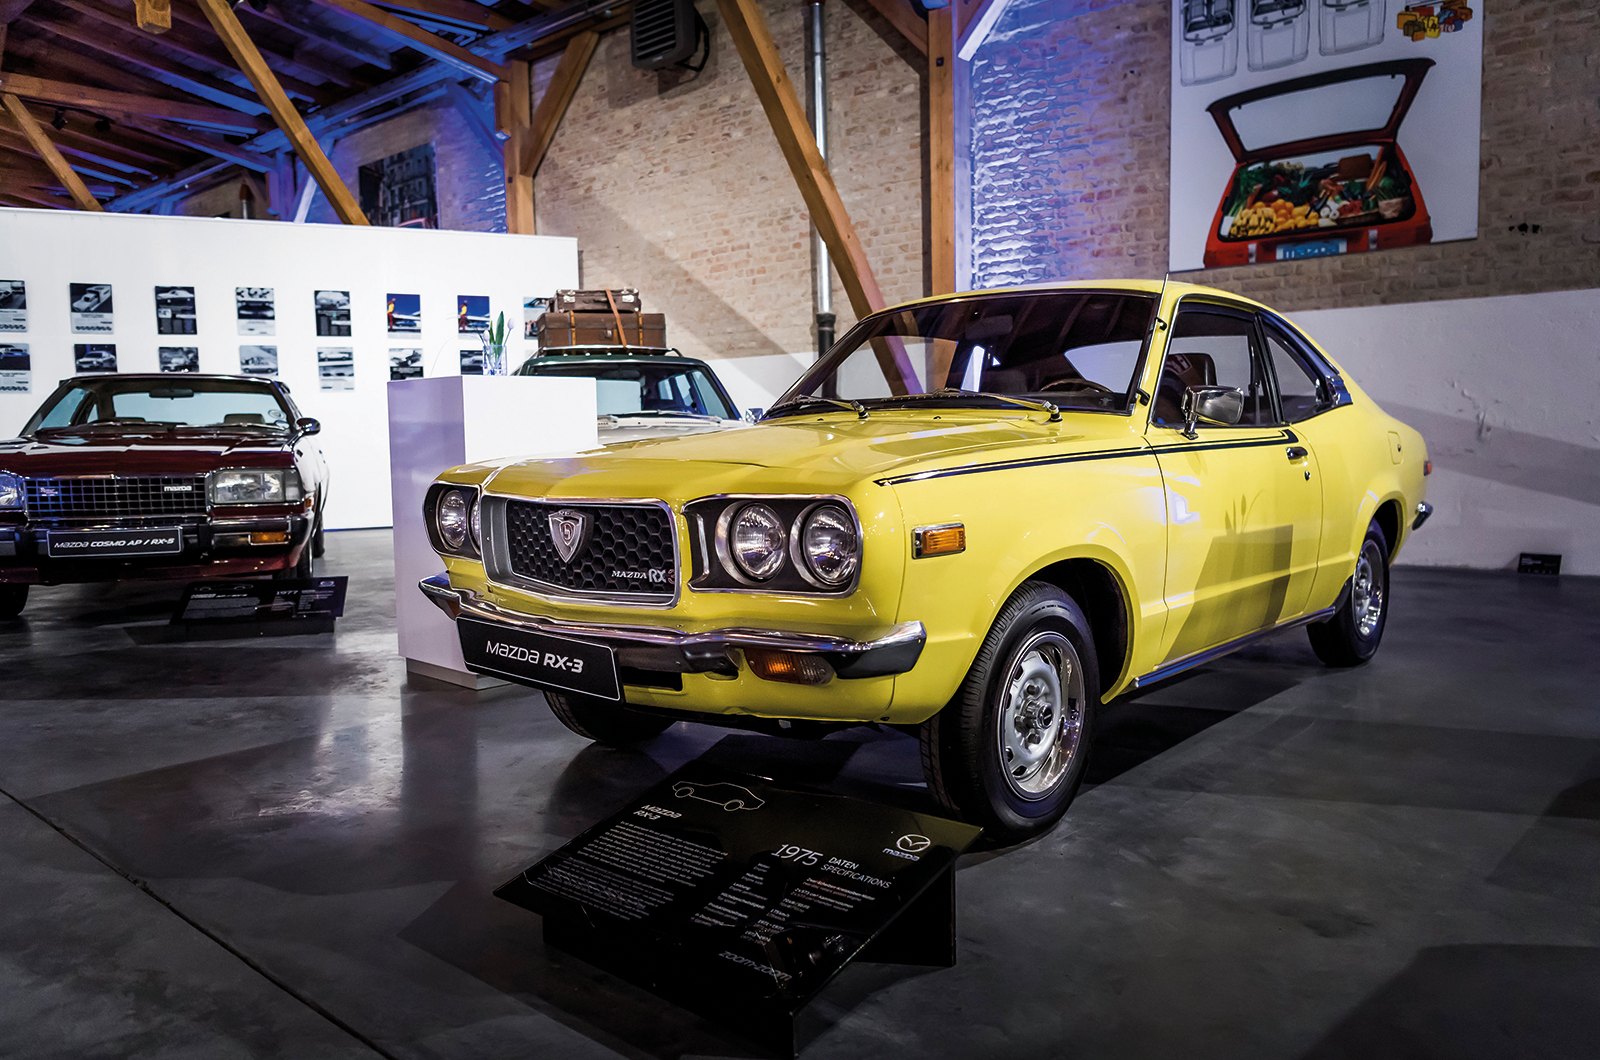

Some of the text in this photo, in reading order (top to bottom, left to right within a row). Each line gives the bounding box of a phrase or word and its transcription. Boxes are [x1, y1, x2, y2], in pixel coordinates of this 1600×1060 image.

[90, 540, 126, 548] COSMO
[127, 539, 142, 547] AP
[150, 537, 175, 545] RX-5
[611, 570, 647, 579] MAZDA
[543, 653, 584, 673] RX-3
[771, 843, 823, 866] 1975
[828, 856, 860, 870] DATEN
[820, 863, 892, 889] SPECIFICATIONS
[718, 950, 792, 981] zoom-zoom
